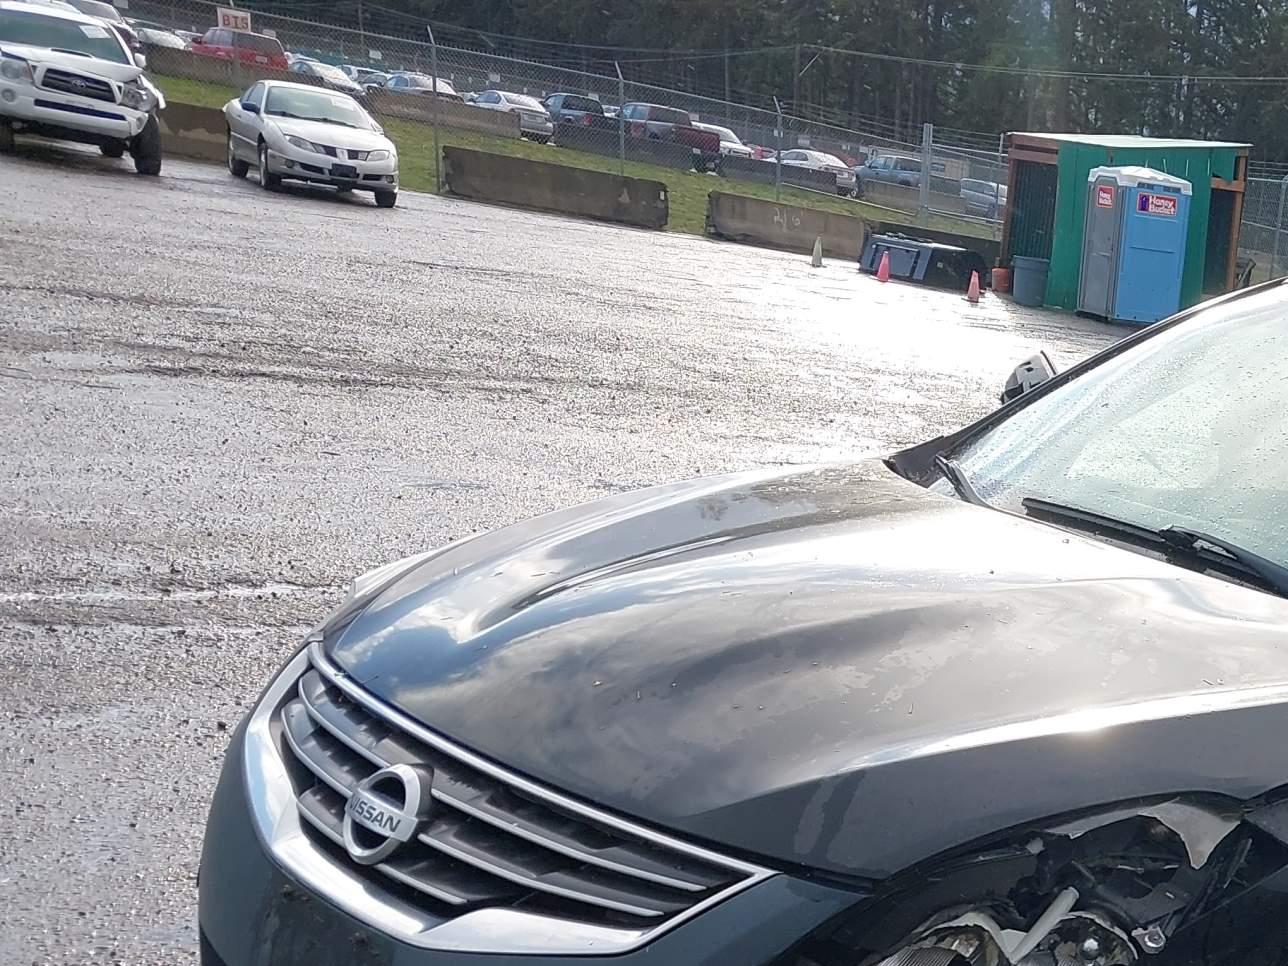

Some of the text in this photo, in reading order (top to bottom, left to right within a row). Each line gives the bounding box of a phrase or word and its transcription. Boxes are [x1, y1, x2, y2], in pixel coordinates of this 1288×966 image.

[1149, 195, 1175, 209] Honey
[1149, 204, 1175, 215] Bucket
[350, 795, 402, 833] NISSAN
